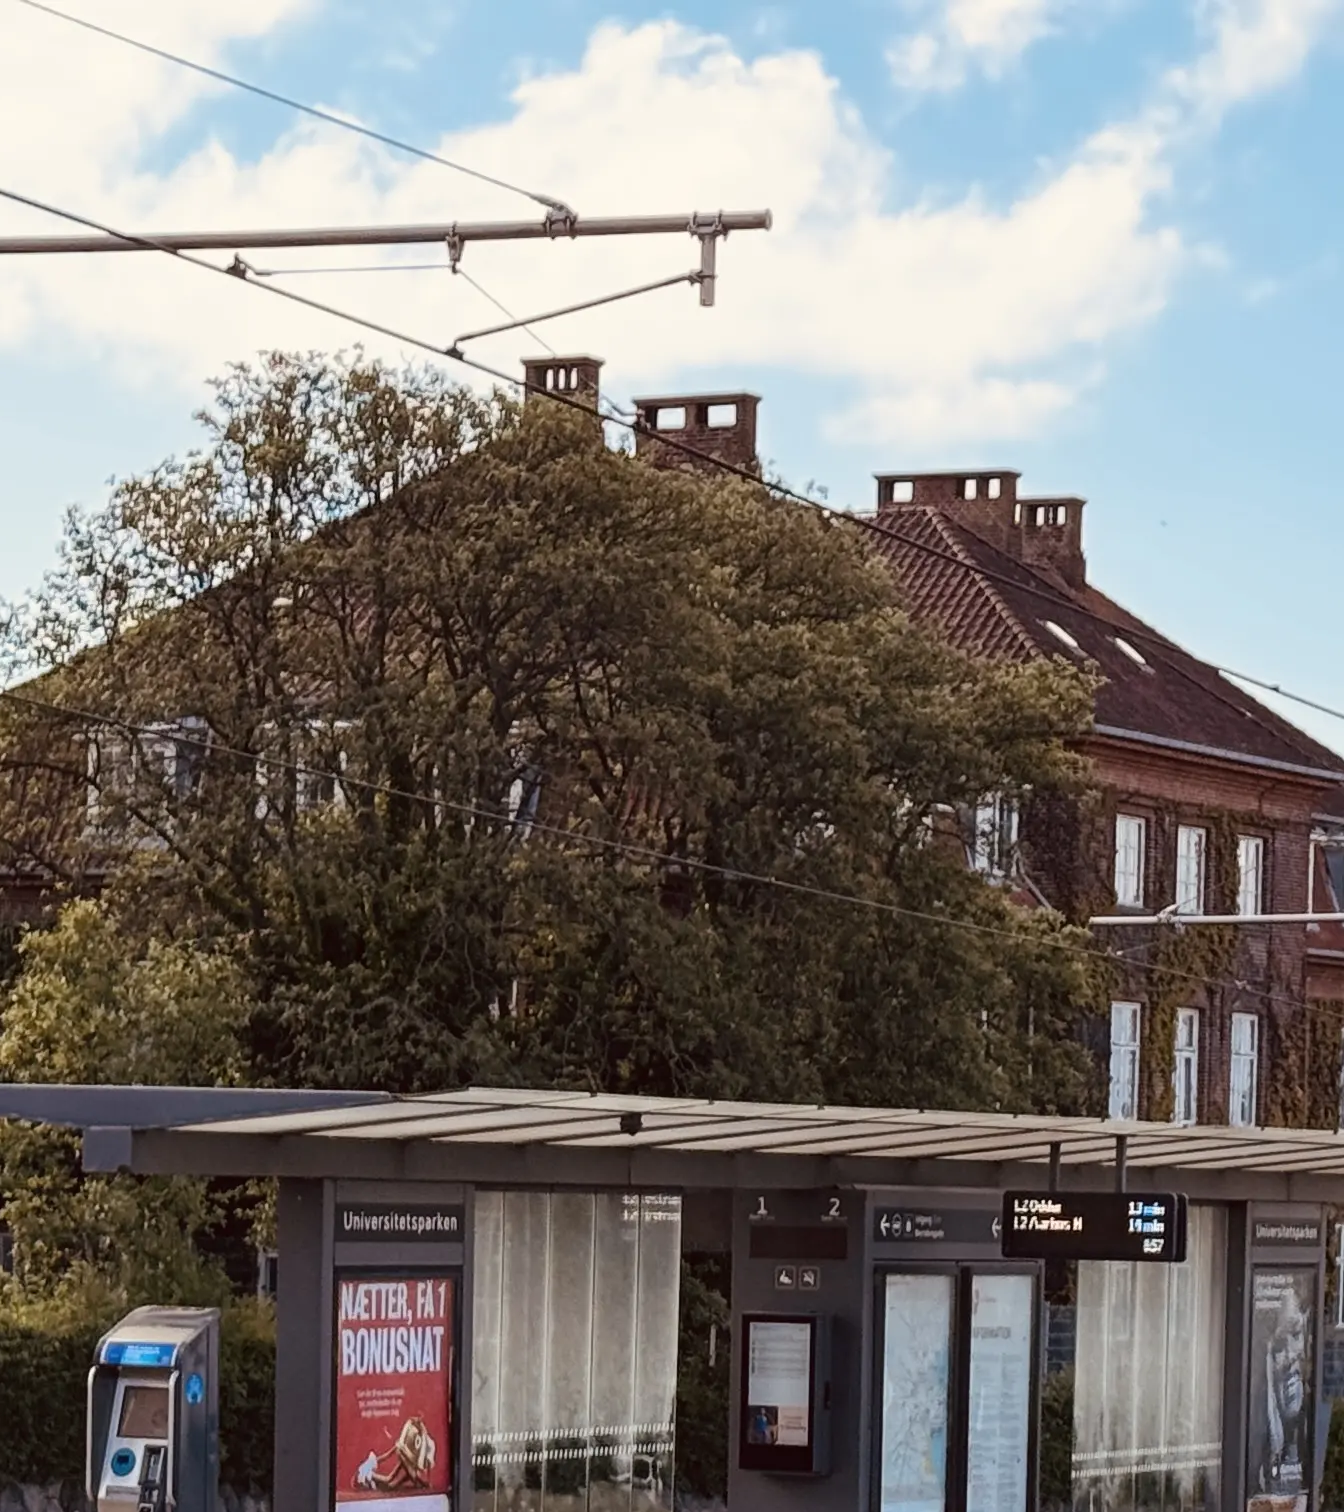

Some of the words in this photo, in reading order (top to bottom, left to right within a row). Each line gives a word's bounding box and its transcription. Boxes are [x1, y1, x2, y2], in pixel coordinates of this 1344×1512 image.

[757, 1196, 768, 1215] 1
[829, 1197, 840, 1216] 2
[343, 1211, 457, 1234] Universitetsparken
[341, 1282, 413, 1325] NÆTTER,
[438, 1282, 446, 1318] 1
[341, 1326, 445, 1375] BONUSNAT
